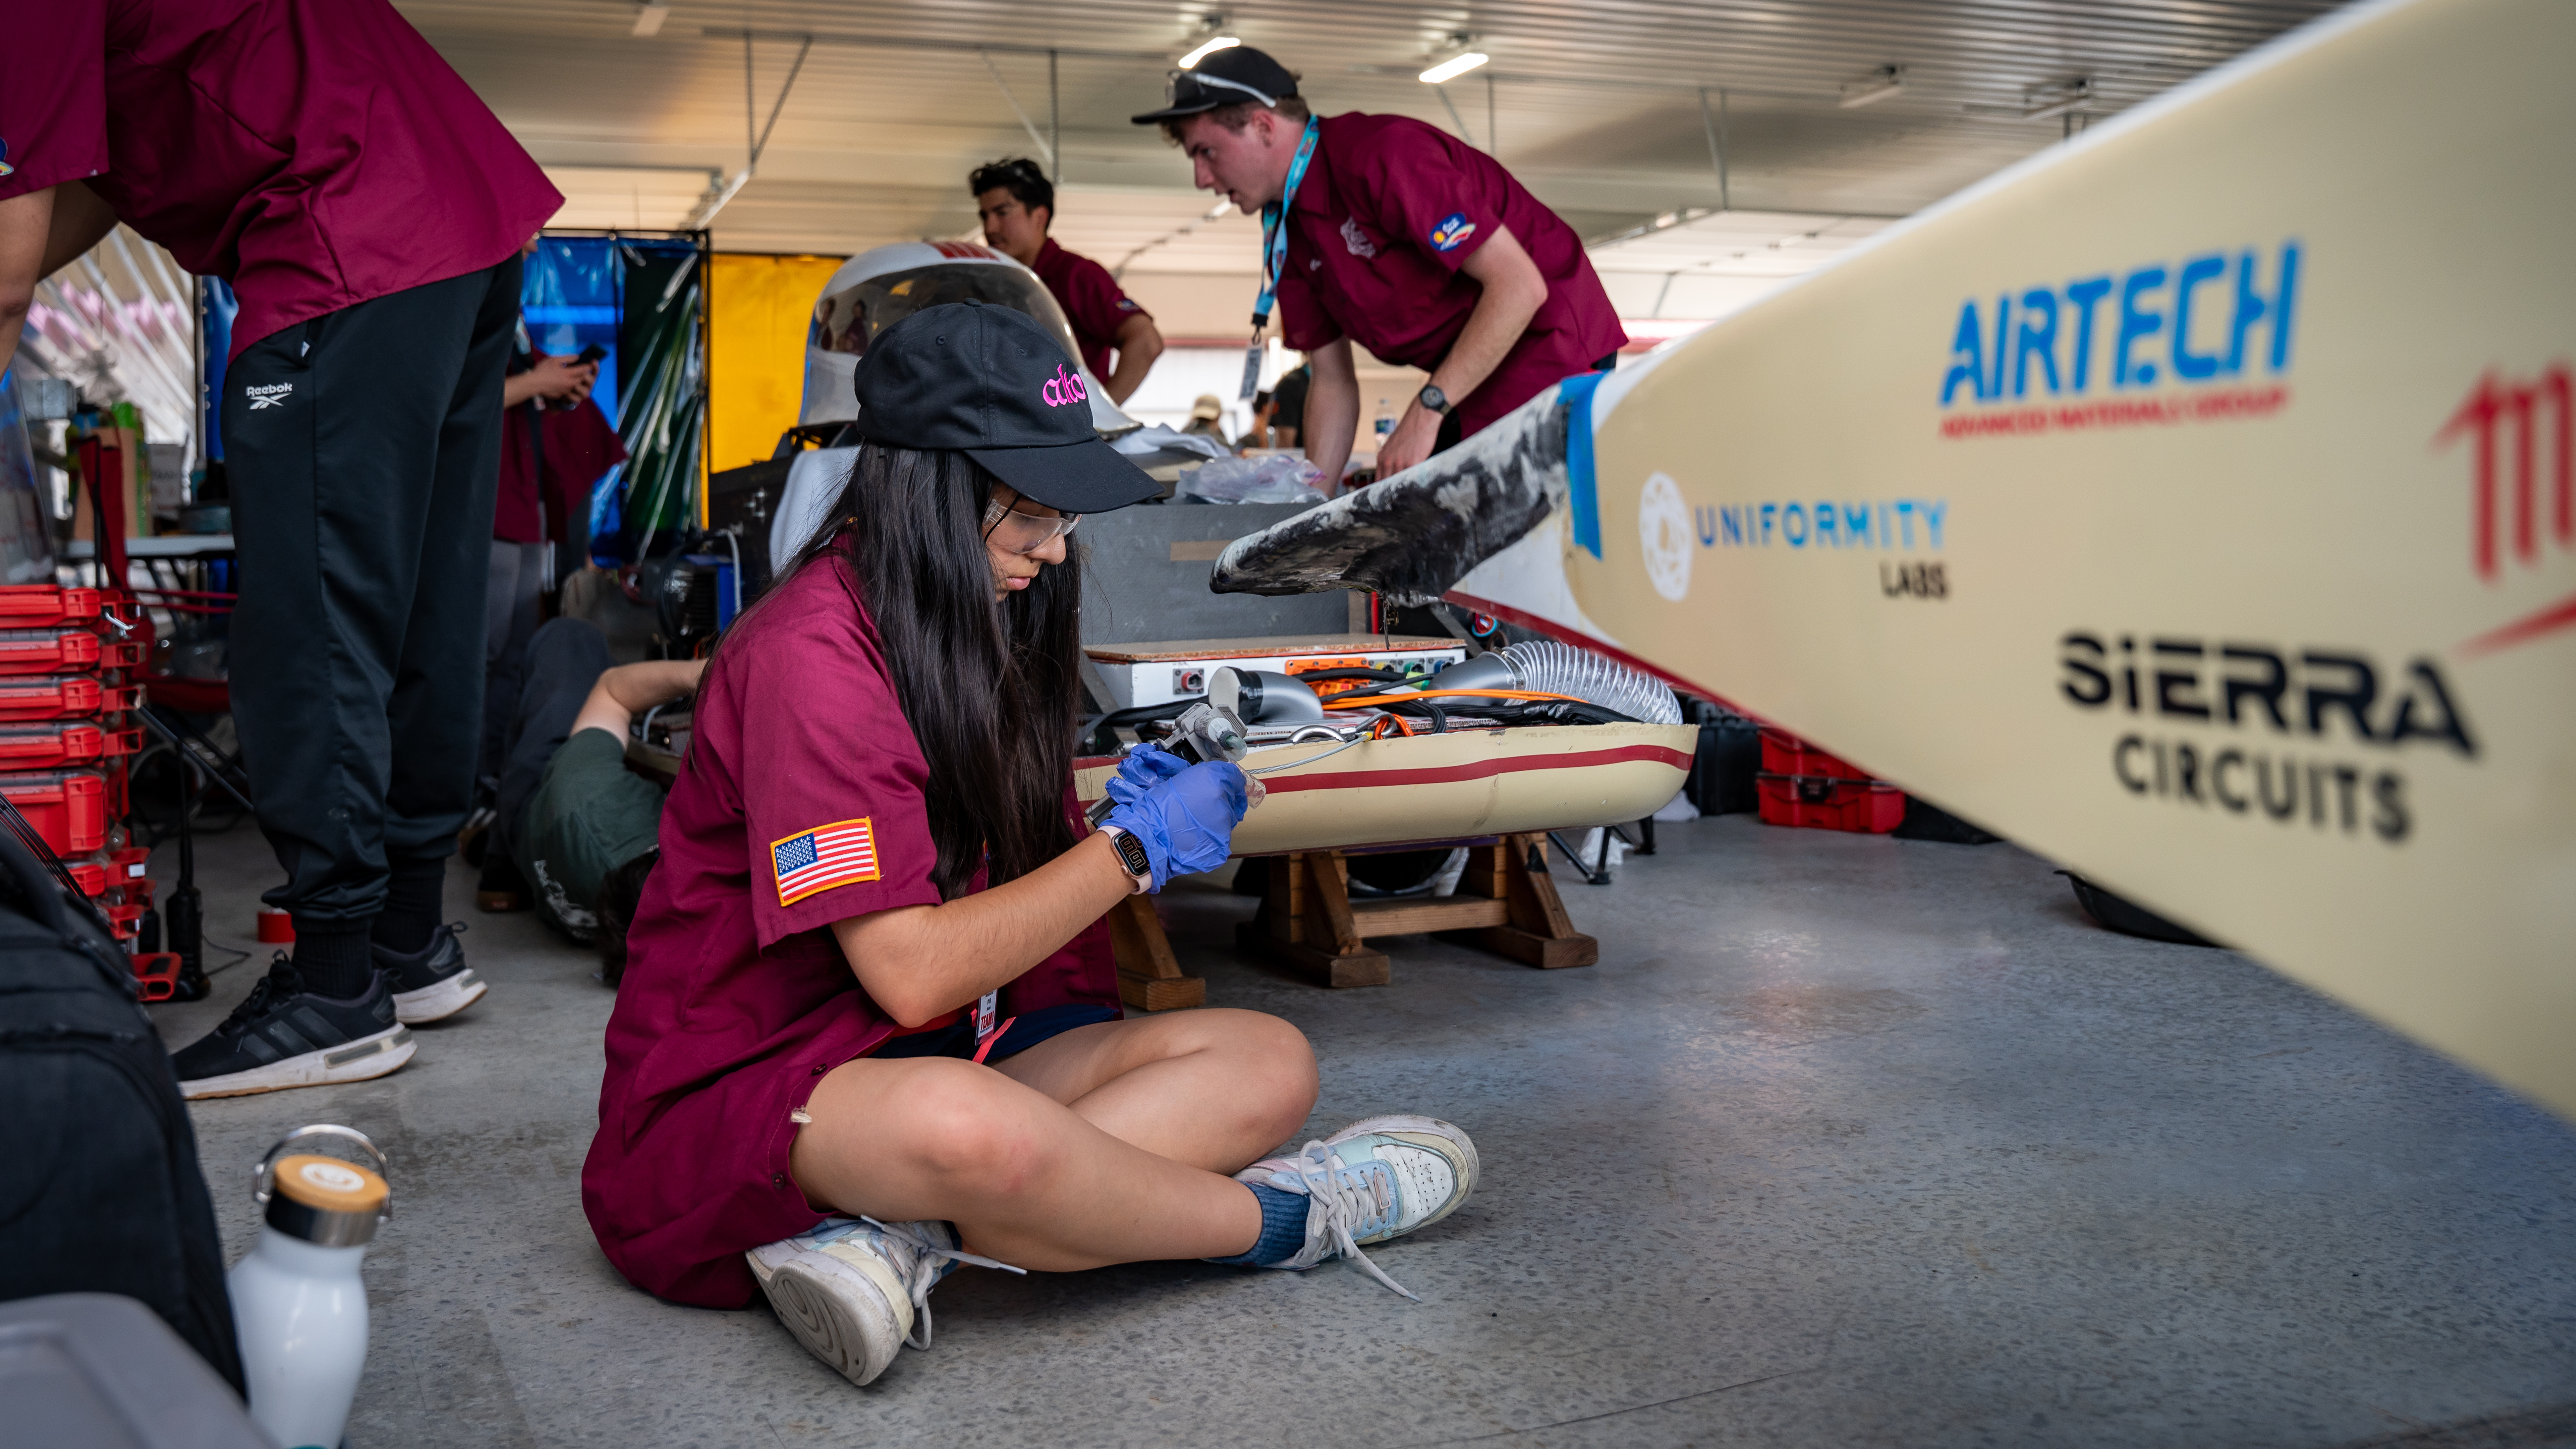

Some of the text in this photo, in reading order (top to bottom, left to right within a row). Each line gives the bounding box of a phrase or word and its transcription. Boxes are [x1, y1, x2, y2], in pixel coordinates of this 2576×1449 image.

[1937, 240, 2303, 406] AIRTECH
[246, 382, 292, 396] Reebok
[1940, 407, 2048, 439] ADVANCED
[1694, 499, 1947, 551] UNIFORMITY
[1879, 561, 1949, 599] LABS
[2113, 733, 2412, 846] CIRCUITS
[981, 1012, 992, 1030] TEAM
